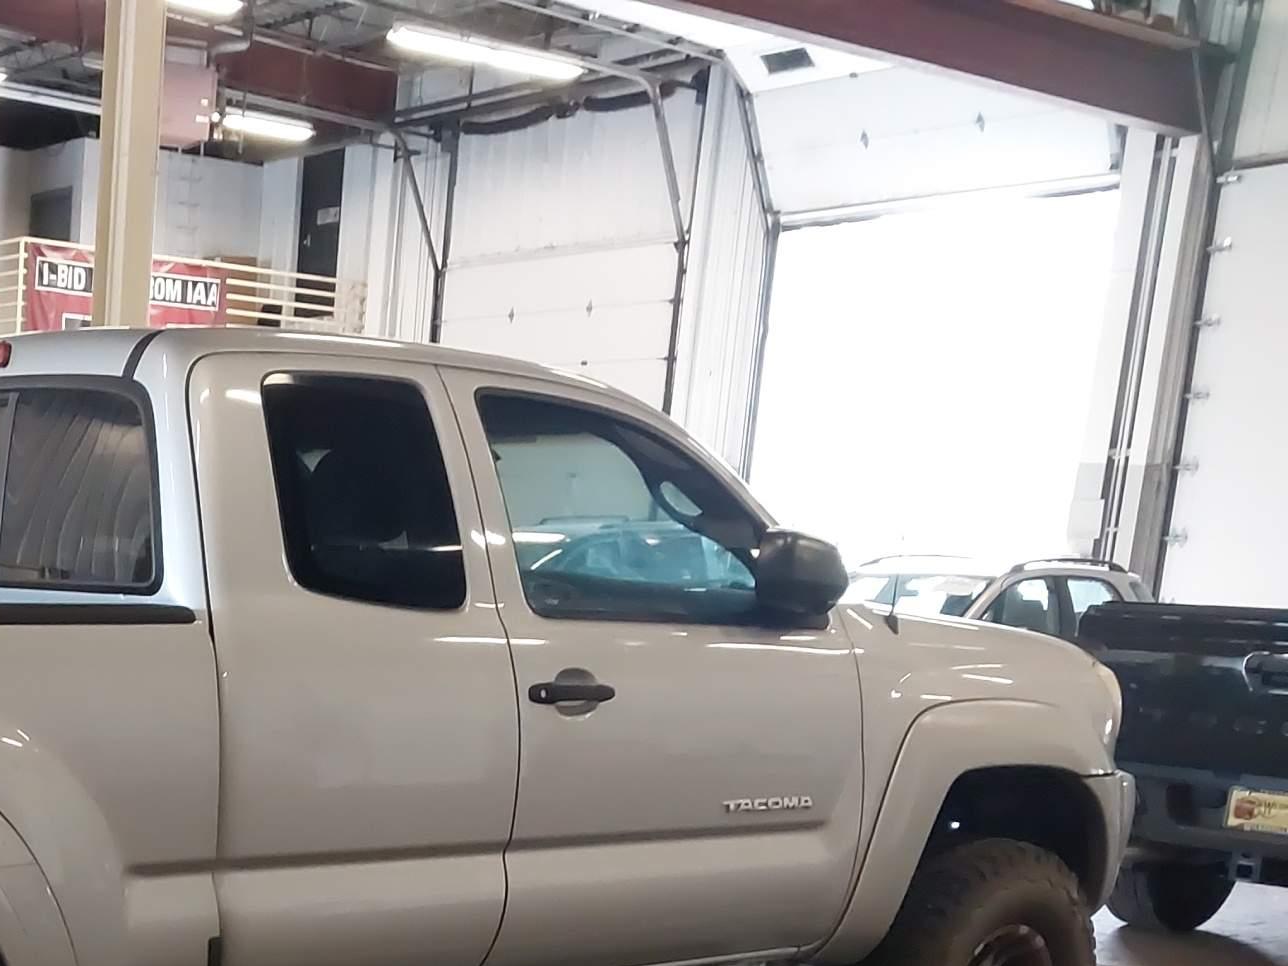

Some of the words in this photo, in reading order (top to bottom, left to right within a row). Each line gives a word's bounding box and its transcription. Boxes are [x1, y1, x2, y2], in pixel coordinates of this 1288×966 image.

[149, 276, 182, 302] OM
[186, 280, 218, 306] IAA
[722, 795, 813, 812] TACOMA
